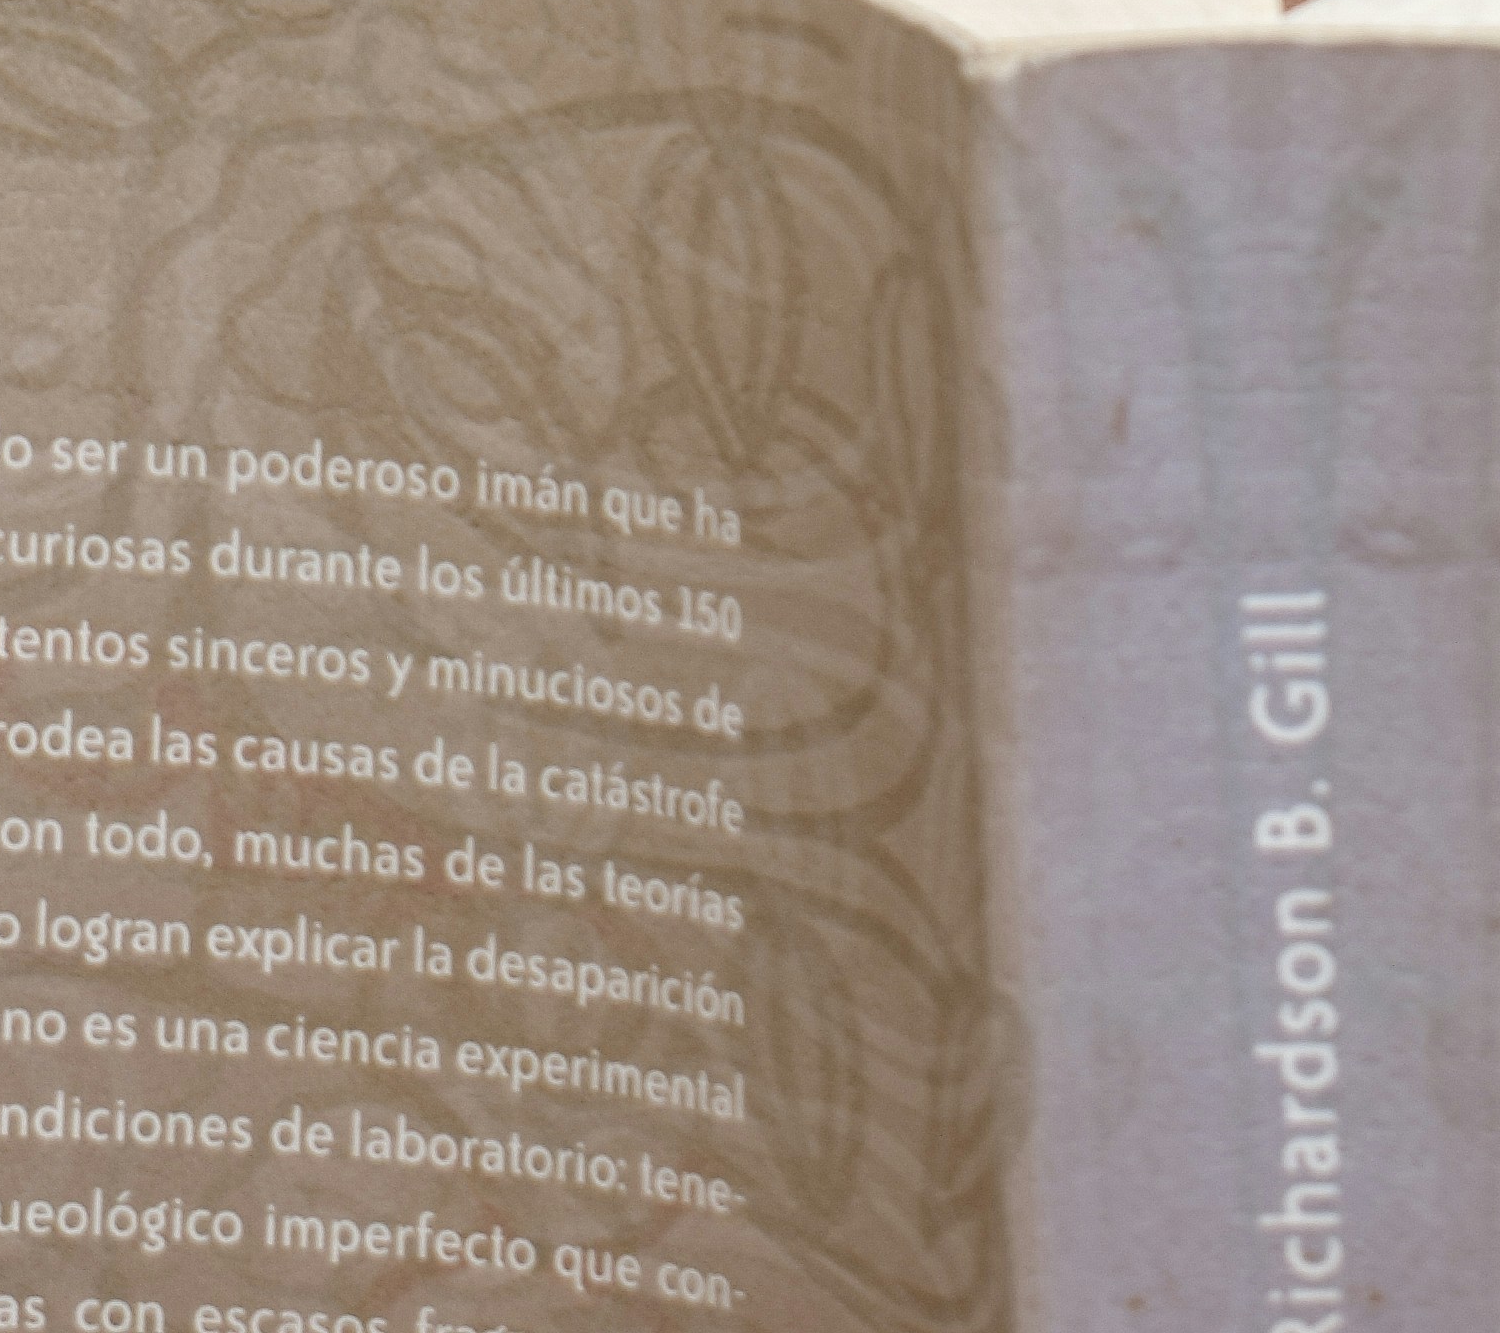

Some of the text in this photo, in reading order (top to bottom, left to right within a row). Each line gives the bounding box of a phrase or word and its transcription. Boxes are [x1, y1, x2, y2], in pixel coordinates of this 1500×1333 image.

[50, 437, 127, 477] ser
[144, 443, 207, 479] un
[225, 439, 460, 501] poderoso
[477, 464, 588, 515] imán
[602, 486, 681, 535] que
[694, 487, 740, 546] ha
[208, 528, 403, 591] durante
[416, 544, 485, 600] los
[500, 557, 663, 628] últimos
[676, 587, 742, 644] 150
[167, 627, 371, 685] sinceros
[386, 652, 413, 699] y
[427, 651, 683, 725] minuciosos
[693, 685, 744, 739] de
[1239, 590, 1330, 745] Gill
[150, 713, 218, 769] las
[232, 735, 399, 783] causas
[412, 736, 475, 791] de
[488, 743, 527, 797] la
[539, 762, 743, 837] catástrofe
[1252, 780, 1333, 853] B.
[83, 809, 214, 869] todo,
[233, 823, 425, 881] muchas
[443, 836, 506, 890] de
[523, 843, 586, 900] las
[602, 861, 744, 933] teorías
[35, 898, 191, 966] logran
[205, 914, 401, 976] explicar
[412, 925, 453, 978] la
[465, 933, 744, 1026] desaparición
[0, 1008, 68, 1047] no
[81, 1011, 138, 1052] es
[154, 1016, 250, 1057] una
[263, 1015, 441, 1073] ciencia
[454, 1041, 746, 1124] experimental
[269, 1105, 335, 1158] de
[350, 1109, 627, 1192] laboratorio:
[638, 1153, 746, 1215] tene-
[264, 1203, 536, 1274] imperfecto
[553, 1243, 643, 1294] que
[655, 1262, 745, 1310] con-
[73, 1298, 165, 1333] con
